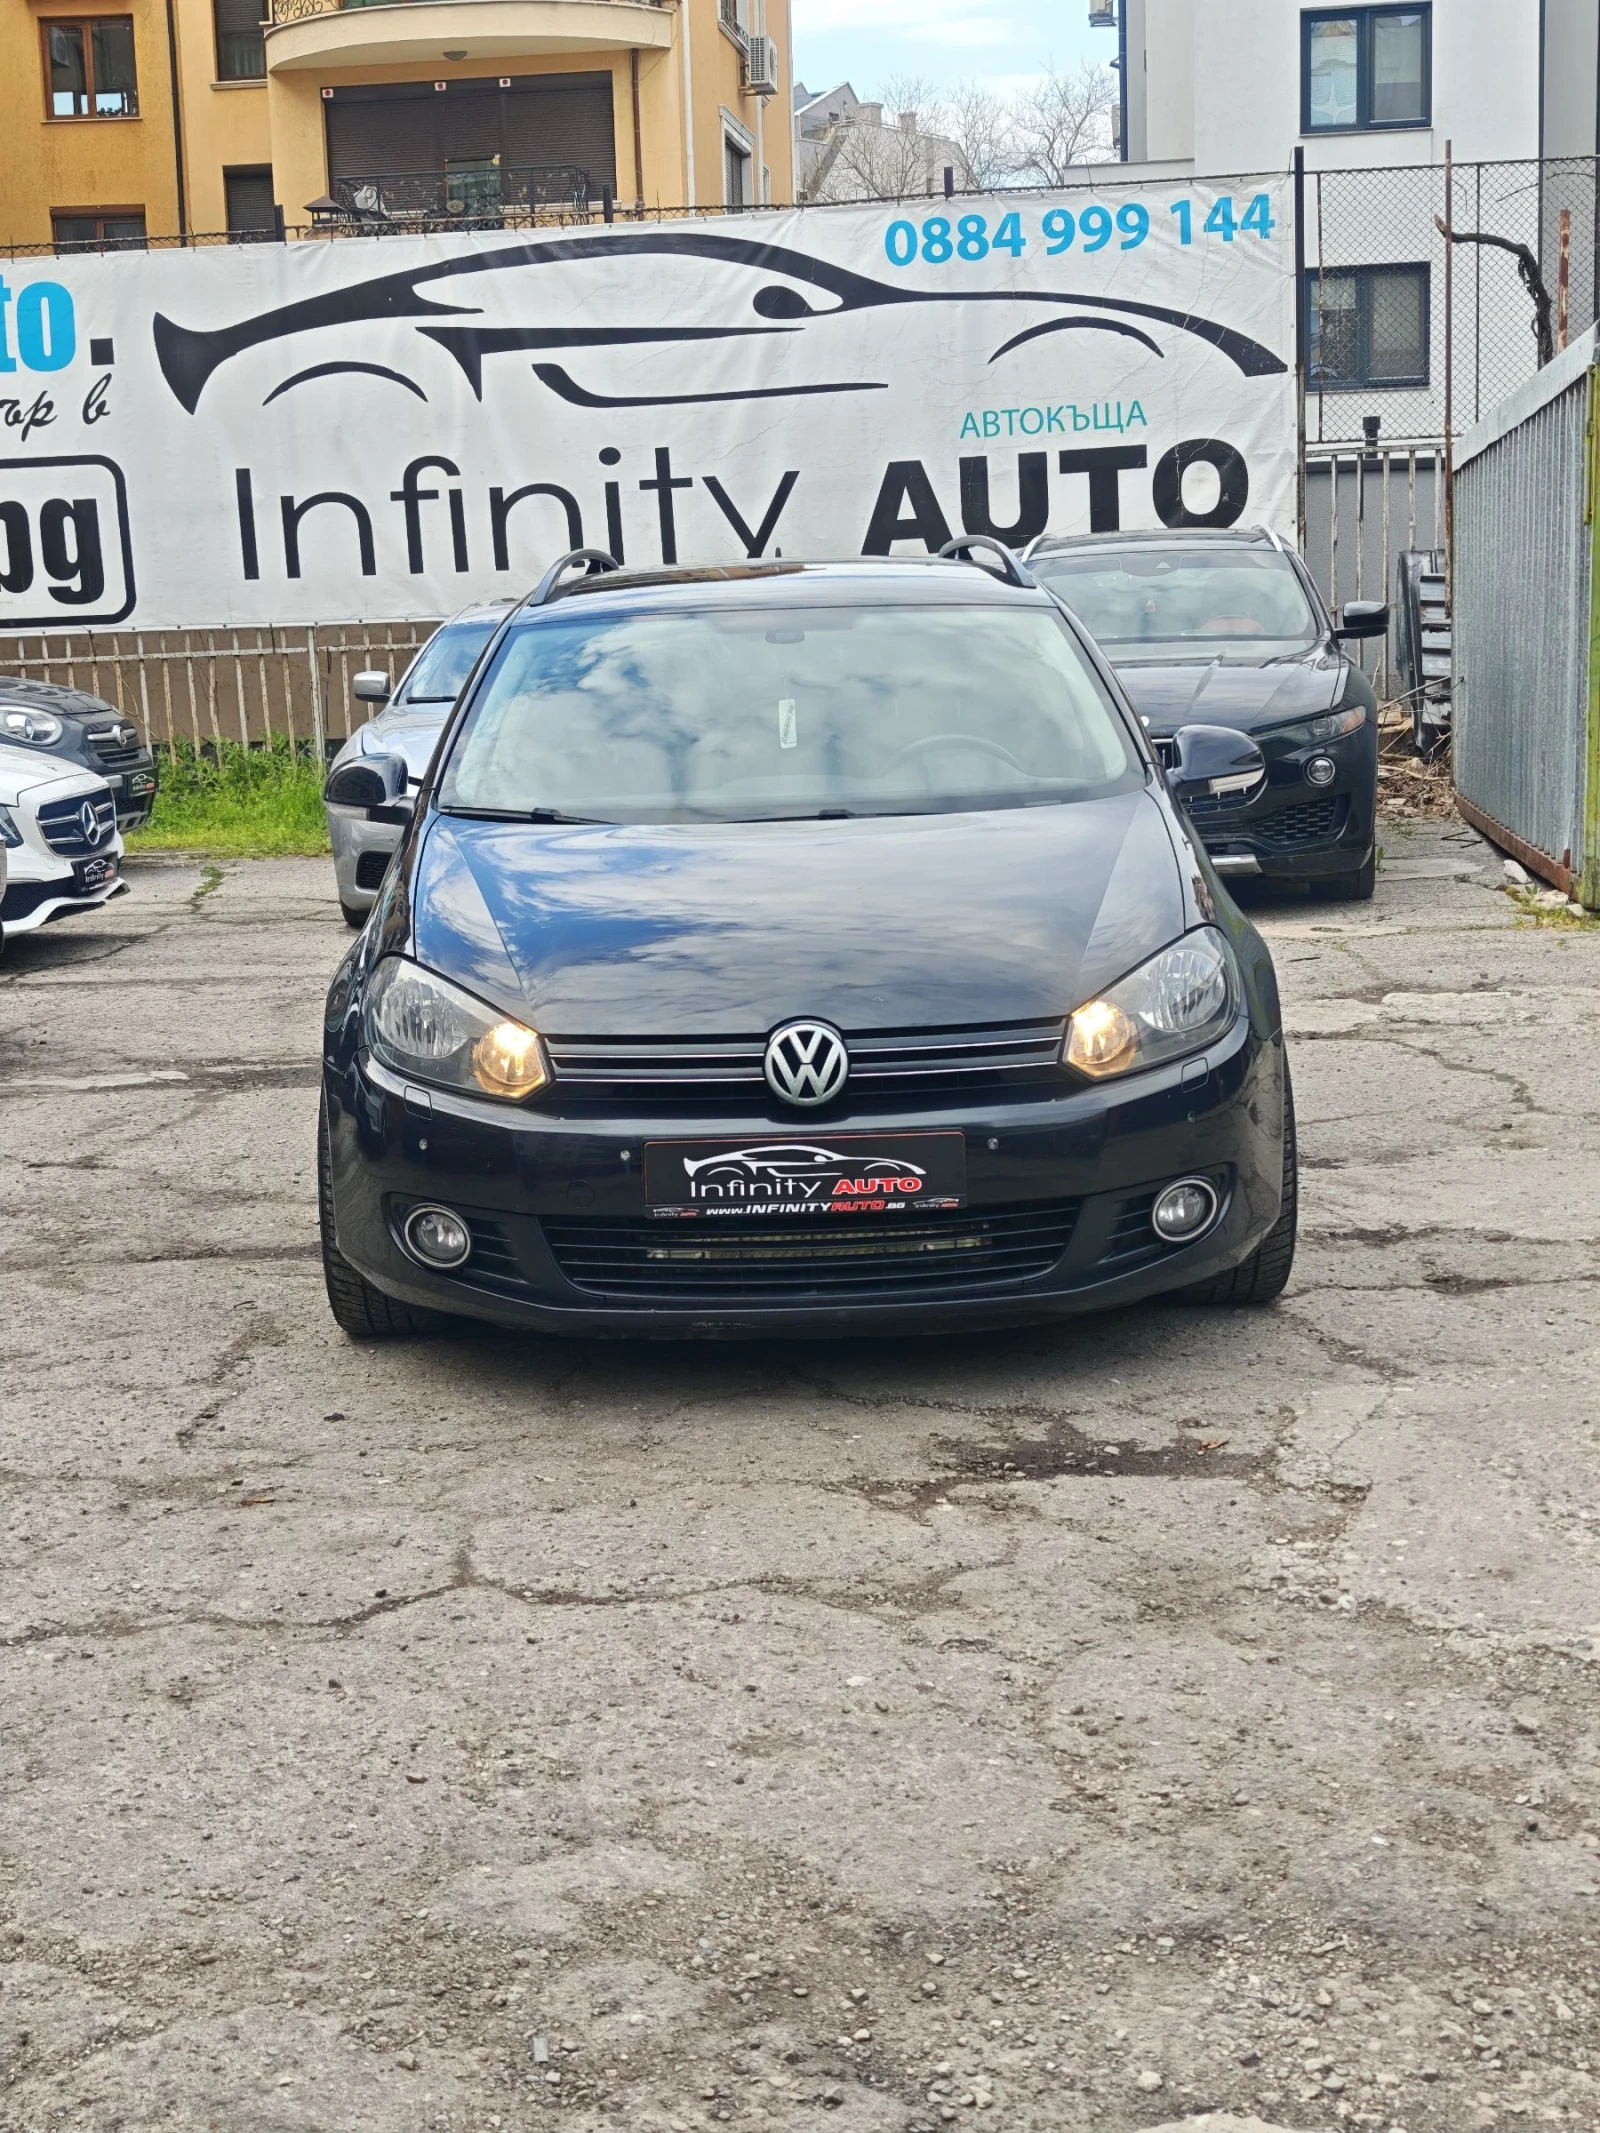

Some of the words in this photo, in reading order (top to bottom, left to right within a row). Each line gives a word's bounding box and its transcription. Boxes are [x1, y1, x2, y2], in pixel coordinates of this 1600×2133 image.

[885, 212, 1026, 266] 0884
[1042, 203, 1150, 256] 999
[1170, 193, 1275, 245] 144
[959, 400, 1147, 439] АВТОКЪЩА
[235, 446, 800, 580] Infinity
[861, 438, 1249, 557] AUTO
[690, 1178, 822, 1198] Infinity
[831, 1177, 922, 1195] AUTO
